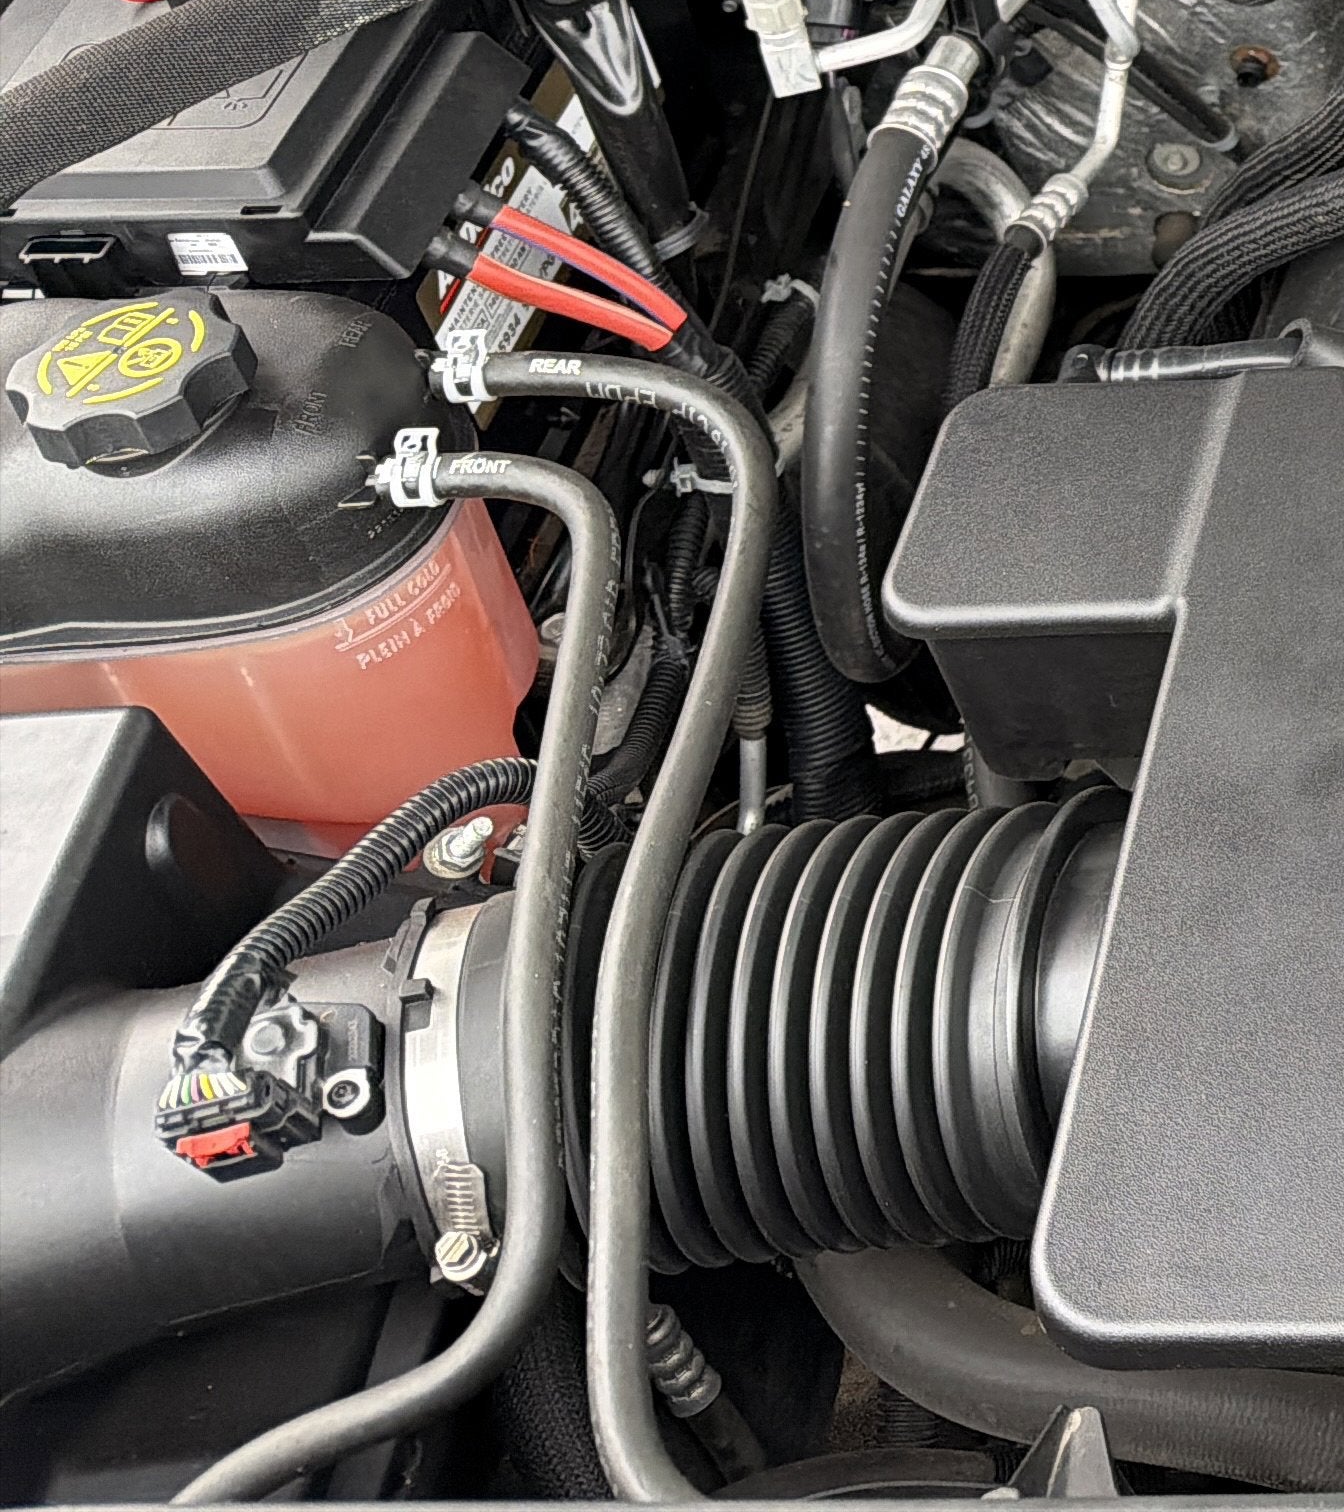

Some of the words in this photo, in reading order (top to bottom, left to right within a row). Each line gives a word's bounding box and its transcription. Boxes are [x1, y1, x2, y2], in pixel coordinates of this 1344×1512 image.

[896, 157, 923, 218] GALAXY
[528, 358, 582, 375] REAR
[449, 456, 512, 475] FRONT
[364, 594, 406, 625] FULL
[407, 560, 440, 596] COLD
[355, 630, 412, 670] PLEIN
[425, 582, 462, 625] FROID
